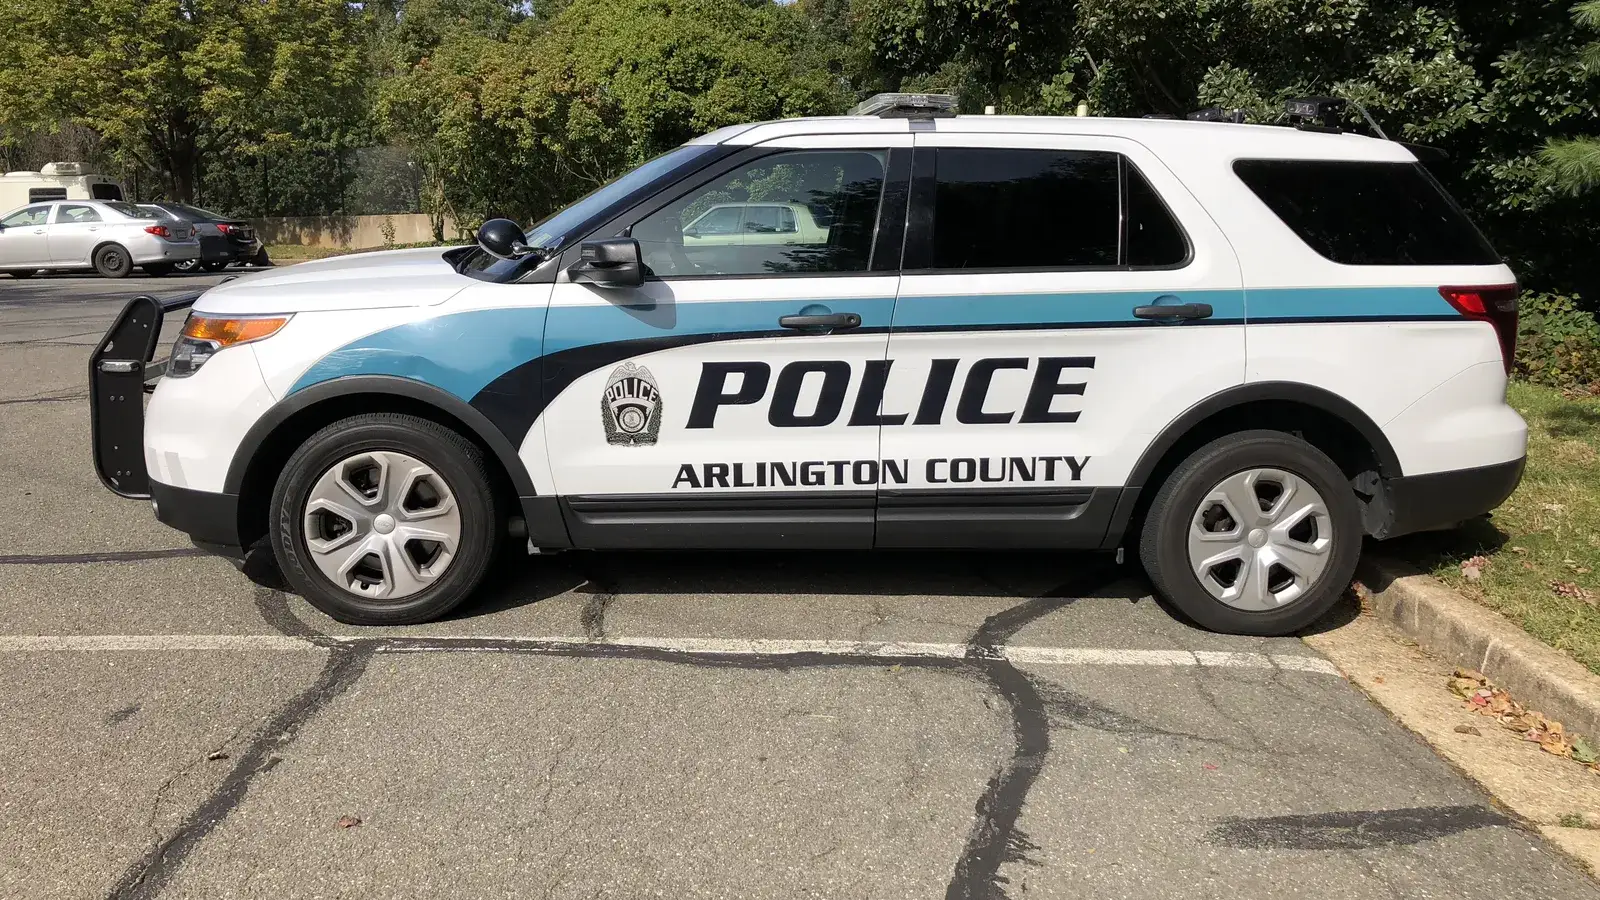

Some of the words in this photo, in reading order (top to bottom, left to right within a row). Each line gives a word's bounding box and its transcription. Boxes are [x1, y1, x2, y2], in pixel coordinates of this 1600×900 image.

[605, 378, 659, 403] POLICE
[685, 356, 1096, 429] POLICE
[671, 458, 908, 489] ARLINGTON
[926, 455, 1092, 483] COUNTY
